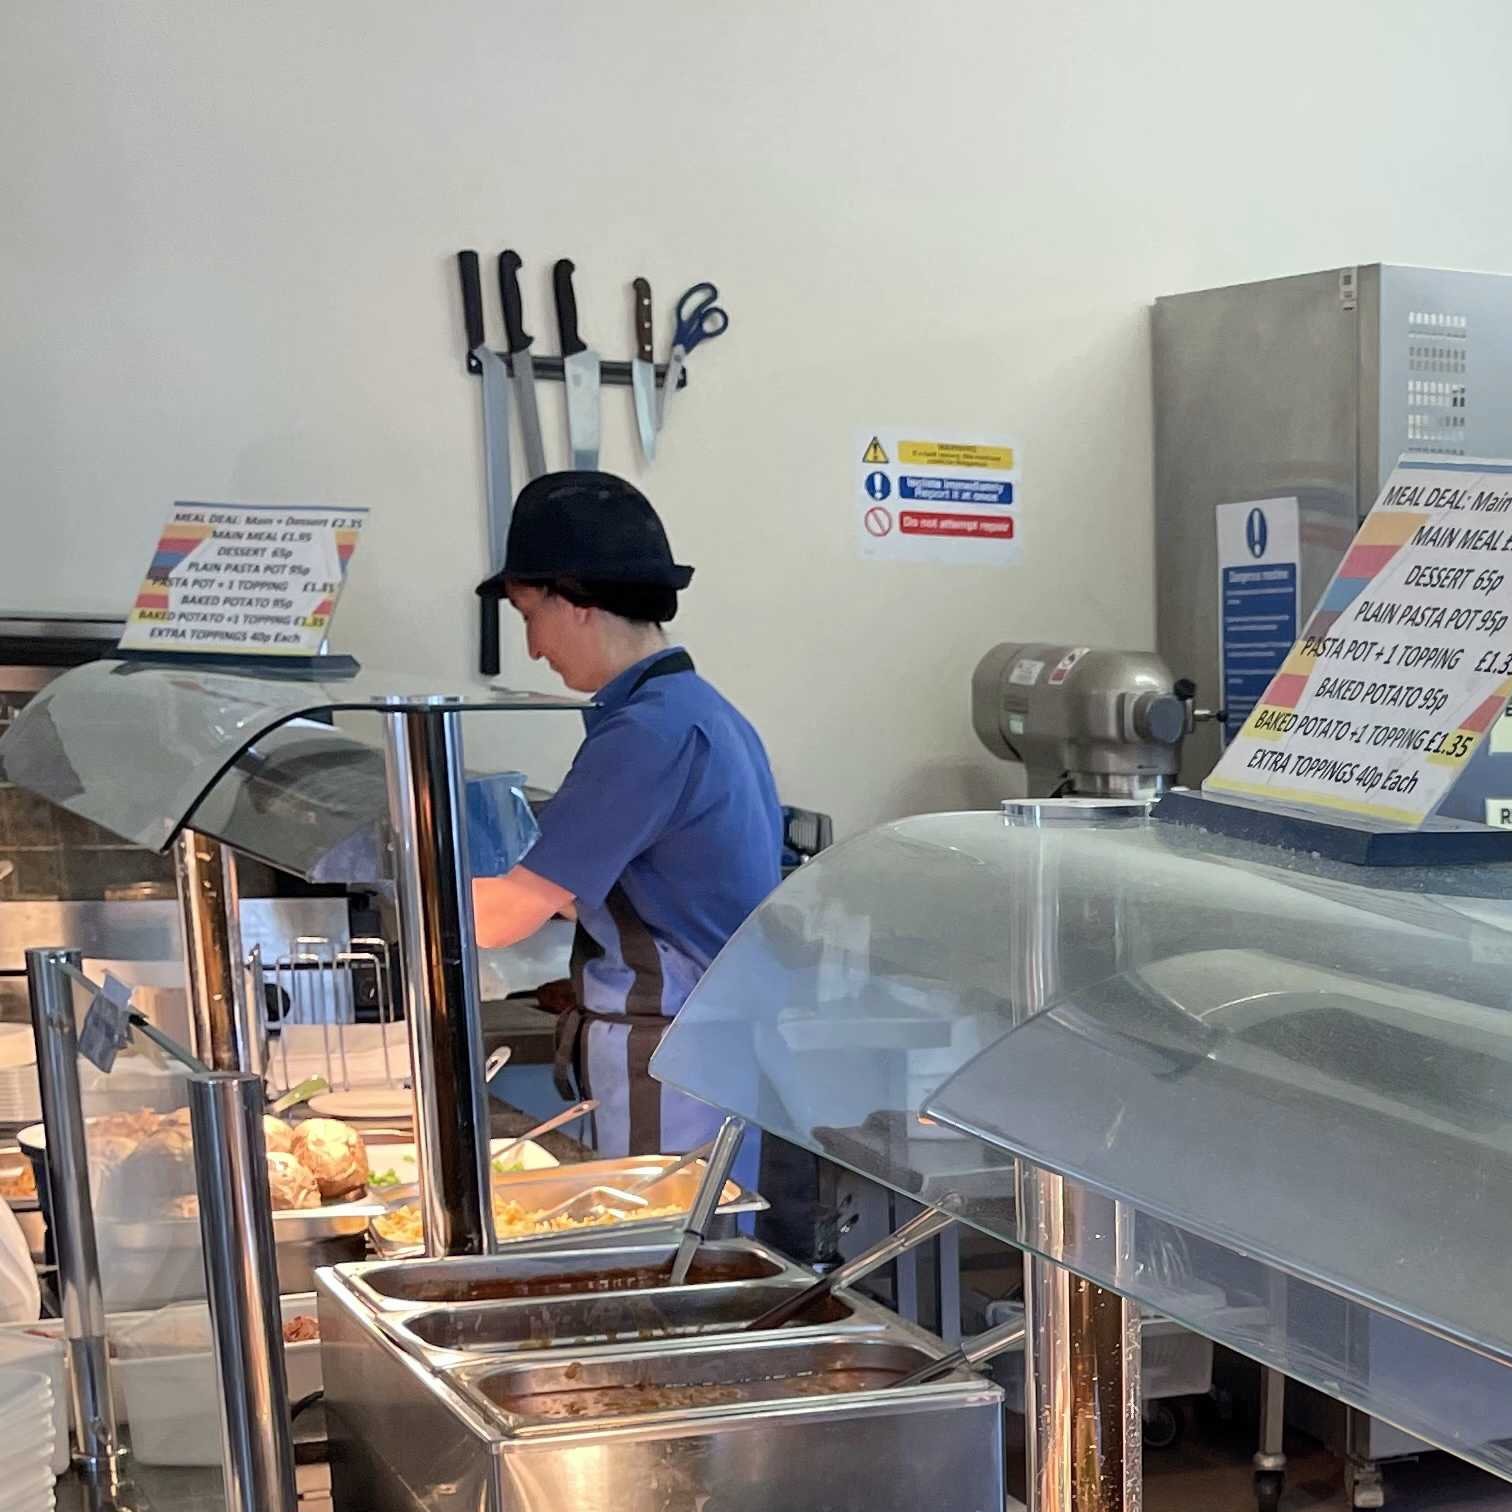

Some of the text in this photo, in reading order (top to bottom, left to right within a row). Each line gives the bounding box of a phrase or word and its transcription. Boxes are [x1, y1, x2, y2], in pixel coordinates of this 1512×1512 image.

[1382, 486, 1423, 506] MEAL
[1424, 487, 1471, 510] DEAL:
[1470, 491, 1512, 512] Main
[174, 513, 205, 523] MEAL
[212, 530, 244, 540] MAIN
[247, 531, 278, 541] MEAL
[1411, 525, 1457, 548] MAIN
[1457, 529, 1503, 551] MEAL
[217, 547, 267, 557] DESSERT
[187, 562, 221, 572] PLAIN
[223, 563, 260, 574] PASTA
[264, 564, 288, 574] POT
[191, 578, 216, 588] POT
[238, 580, 288, 592] TOPPING
[1404, 565, 1505, 596] DESSERT 65p
[181, 595, 218, 605] BAKED
[222, 596, 270, 608] POTATO
[177, 612, 224, 623] POTATO
[1354, 600, 1509, 637] PLAIN PASTA POT 95p
[150, 628, 186, 639] EXTRA
[1300, 636, 1346, 661] PASTA
[1343, 640, 1378, 661] POT
[1375, 646, 1384, 660] +
[1383, 644, 1399, 665] 1
[1397, 648, 1465, 670] TOPPING
[1315, 677, 1449, 714] BAKED POTATO 95p
[1254, 710, 1298, 732] BAKED
[1296, 716, 1352, 741] POTATO
[1366, 724, 1430, 750] TOPPING
[1425, 730, 1474, 757] £1.35
[1247, 749, 1419, 794] EXTRA TOPPINGS 40p Each
